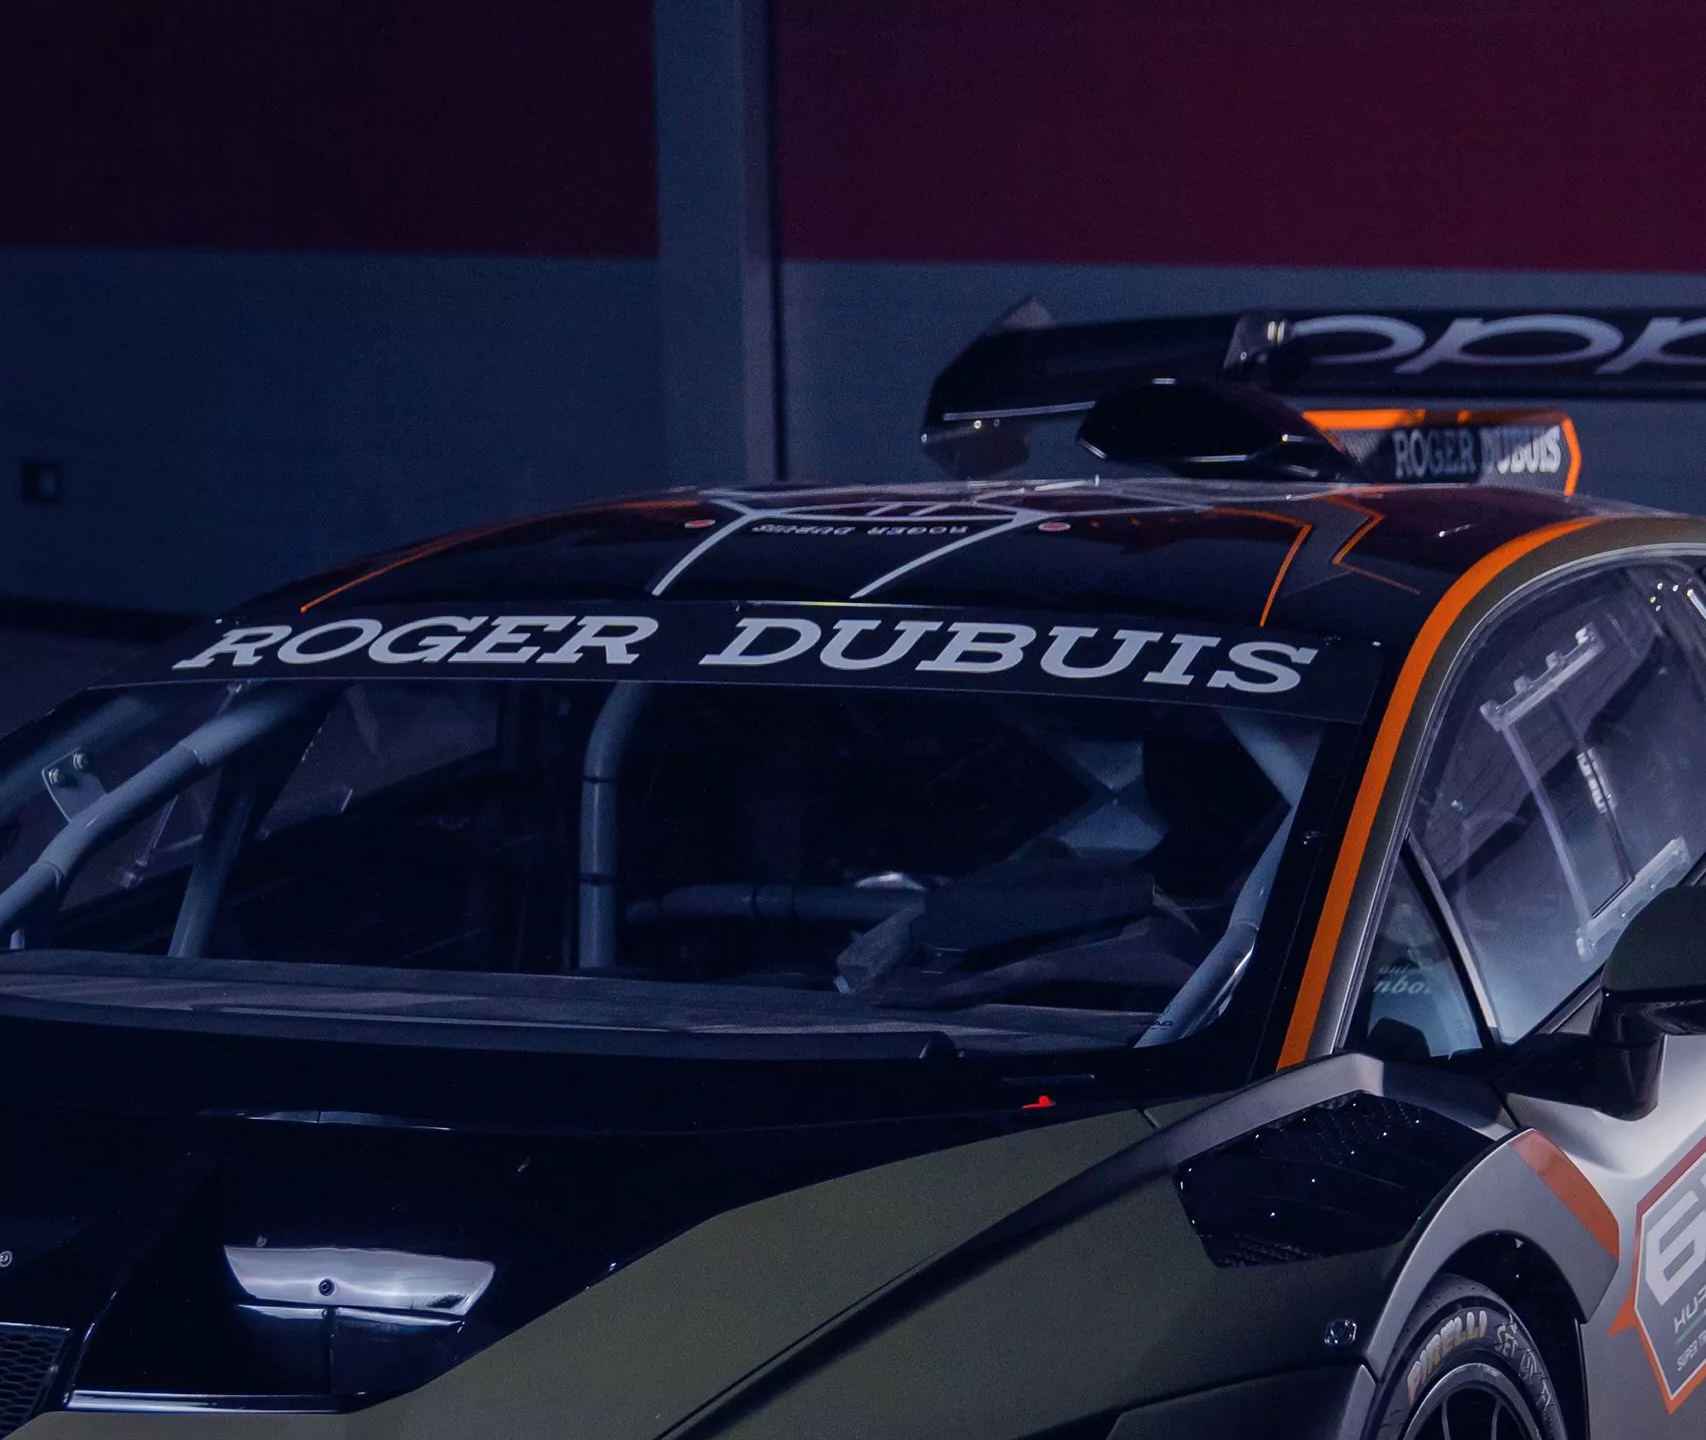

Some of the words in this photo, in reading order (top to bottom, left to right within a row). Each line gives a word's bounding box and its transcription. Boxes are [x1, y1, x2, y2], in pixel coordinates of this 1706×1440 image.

[1391, 427, 1477, 479] ROGER
[866, 524, 969, 536] ROGER
[171, 615, 660, 668] ROGER
[698, 618, 1320, 694] DUBUIS
[1407, 1310, 1488, 1405] PIRELLI
[1677, 1339, 1698, 1372] SUPER
